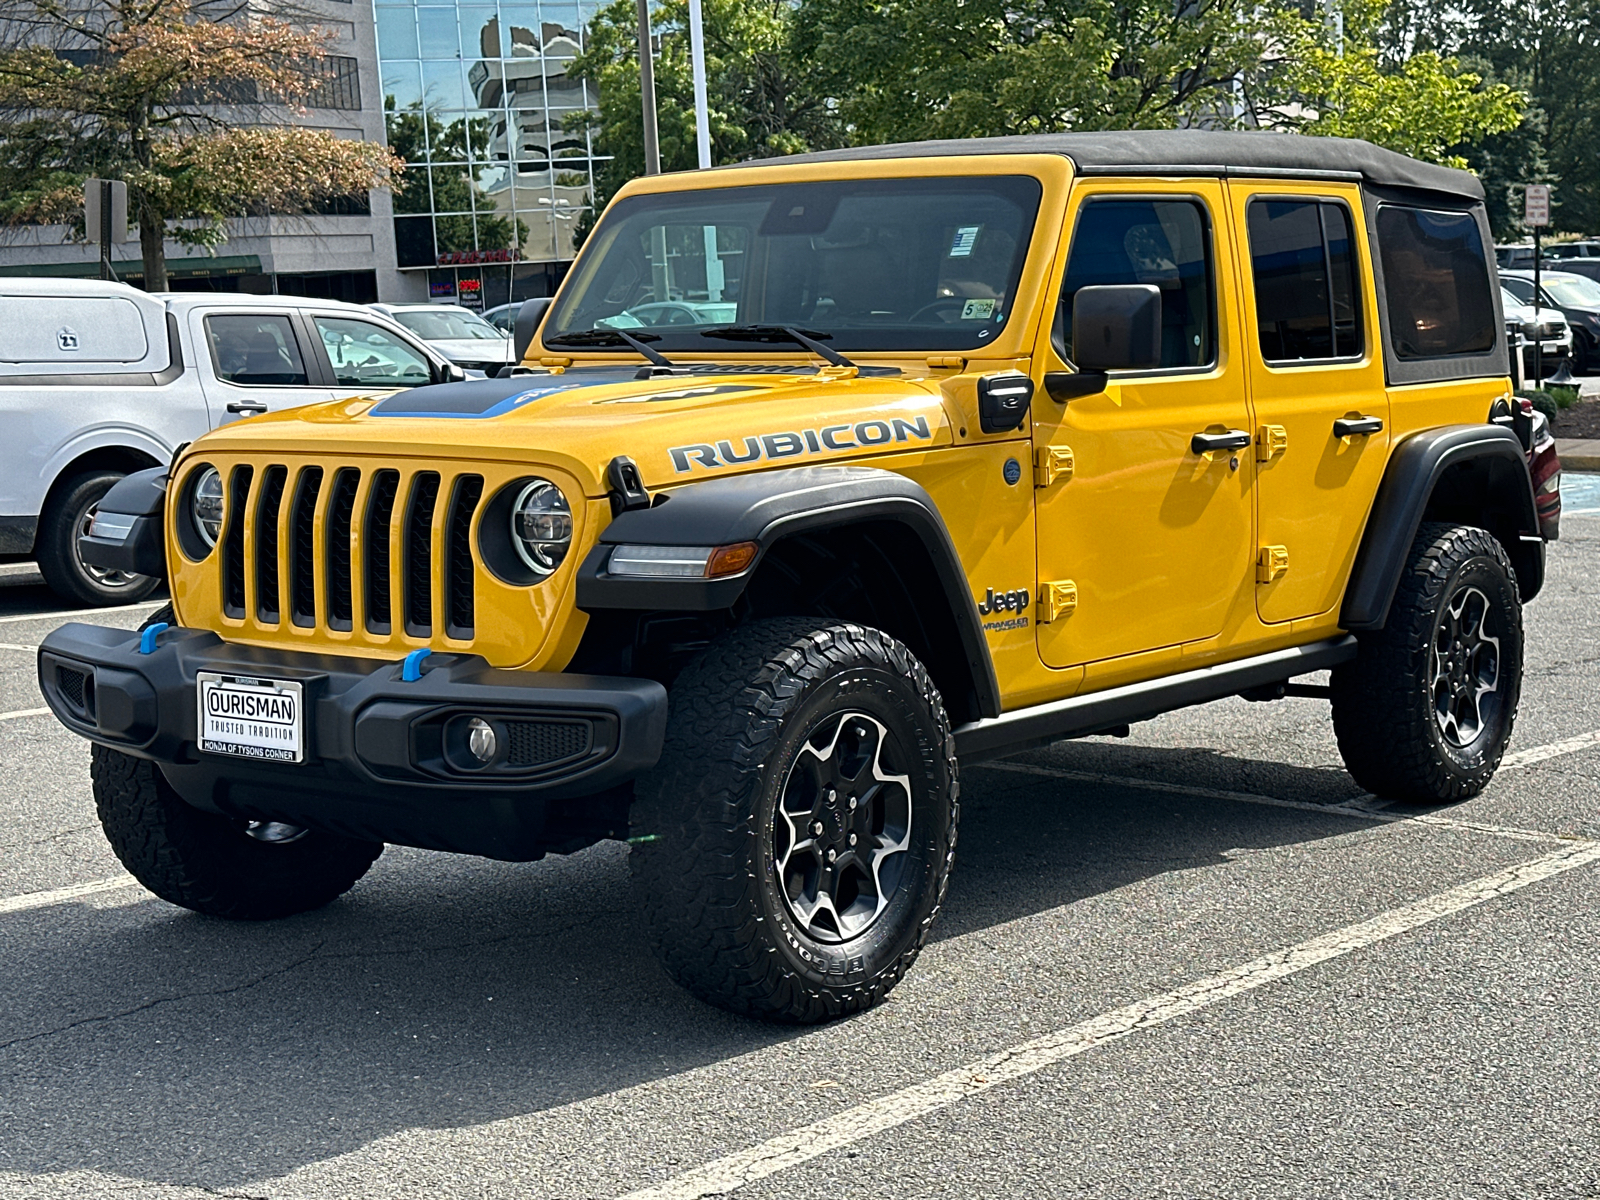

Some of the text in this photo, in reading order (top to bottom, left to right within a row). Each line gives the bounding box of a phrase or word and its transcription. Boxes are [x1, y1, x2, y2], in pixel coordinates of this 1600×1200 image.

[965, 304, 974, 316] 5
[983, 303, 993, 312] 25
[667, 416, 932, 473] RUBICON
[978, 586, 1030, 616] Jeep
[983, 617, 1029, 630] WRANGLER
[210, 692, 292, 720] OURISMAN
[211, 720, 293, 741] TRUSTED TRADITION
[204, 741, 293, 760] HONDA OF TYSONS CORNER
